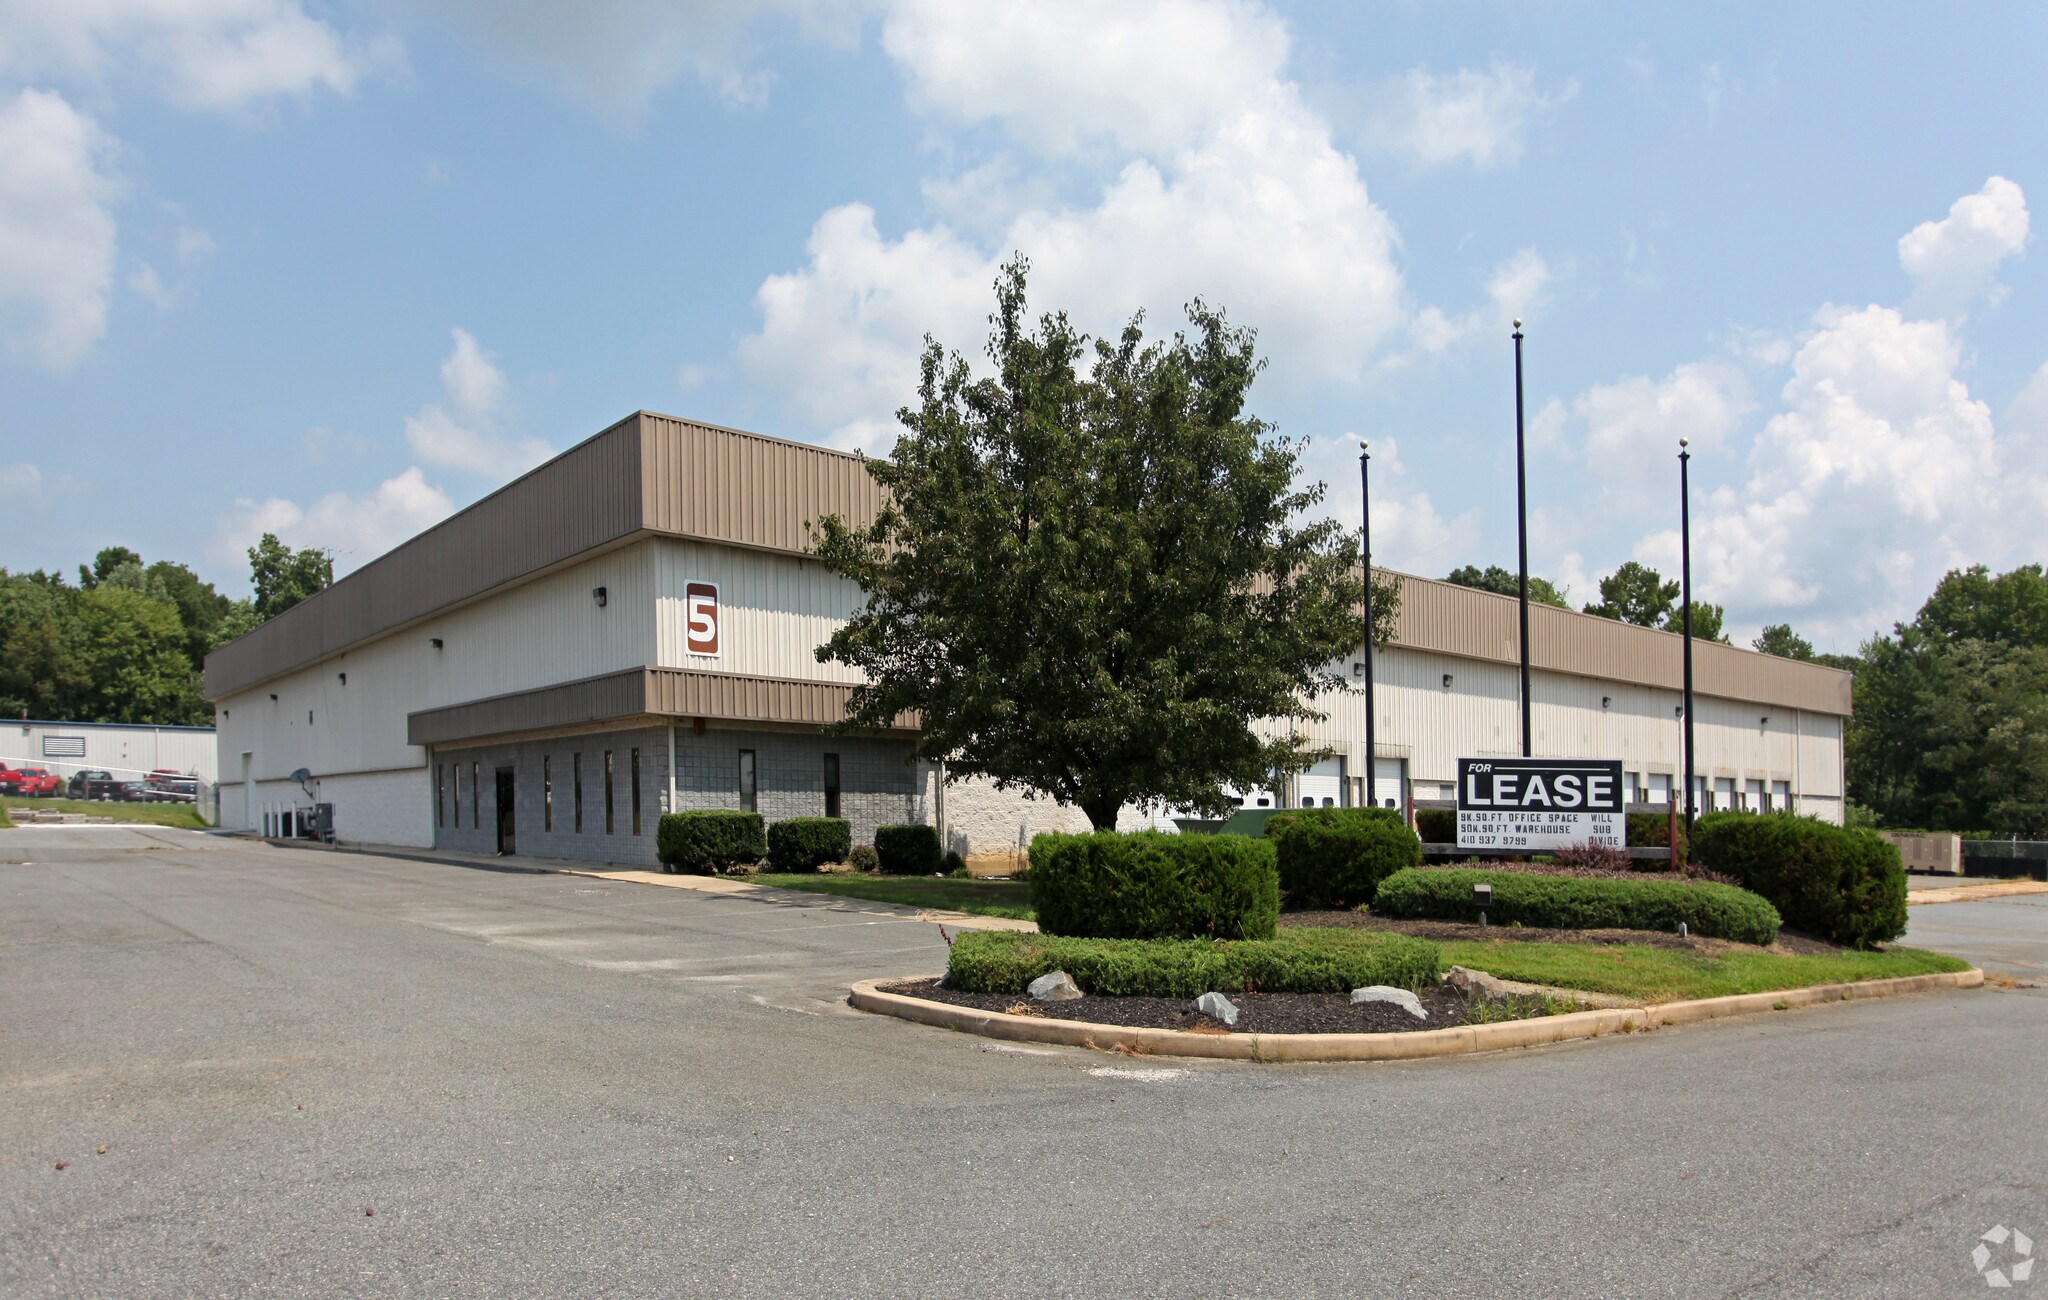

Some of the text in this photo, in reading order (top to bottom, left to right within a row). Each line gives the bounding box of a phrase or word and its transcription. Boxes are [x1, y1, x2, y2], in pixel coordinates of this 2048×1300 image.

[688, 594, 716, 642] 5
[1468, 763, 1492, 773] FOR
[1467, 774, 1614, 808] LEASE
[1508, 813, 1542, 823] OFFICE
[1548, 814, 1579, 823] SPACE
[1590, 814, 1613, 823] WILL
[1515, 824, 1571, 834] WAREHOUSE
[1593, 825, 1611, 834] SUB
[1461, 835, 1527, 846] 410 937 9799
[1588, 836, 1619, 846] DIVIDE
